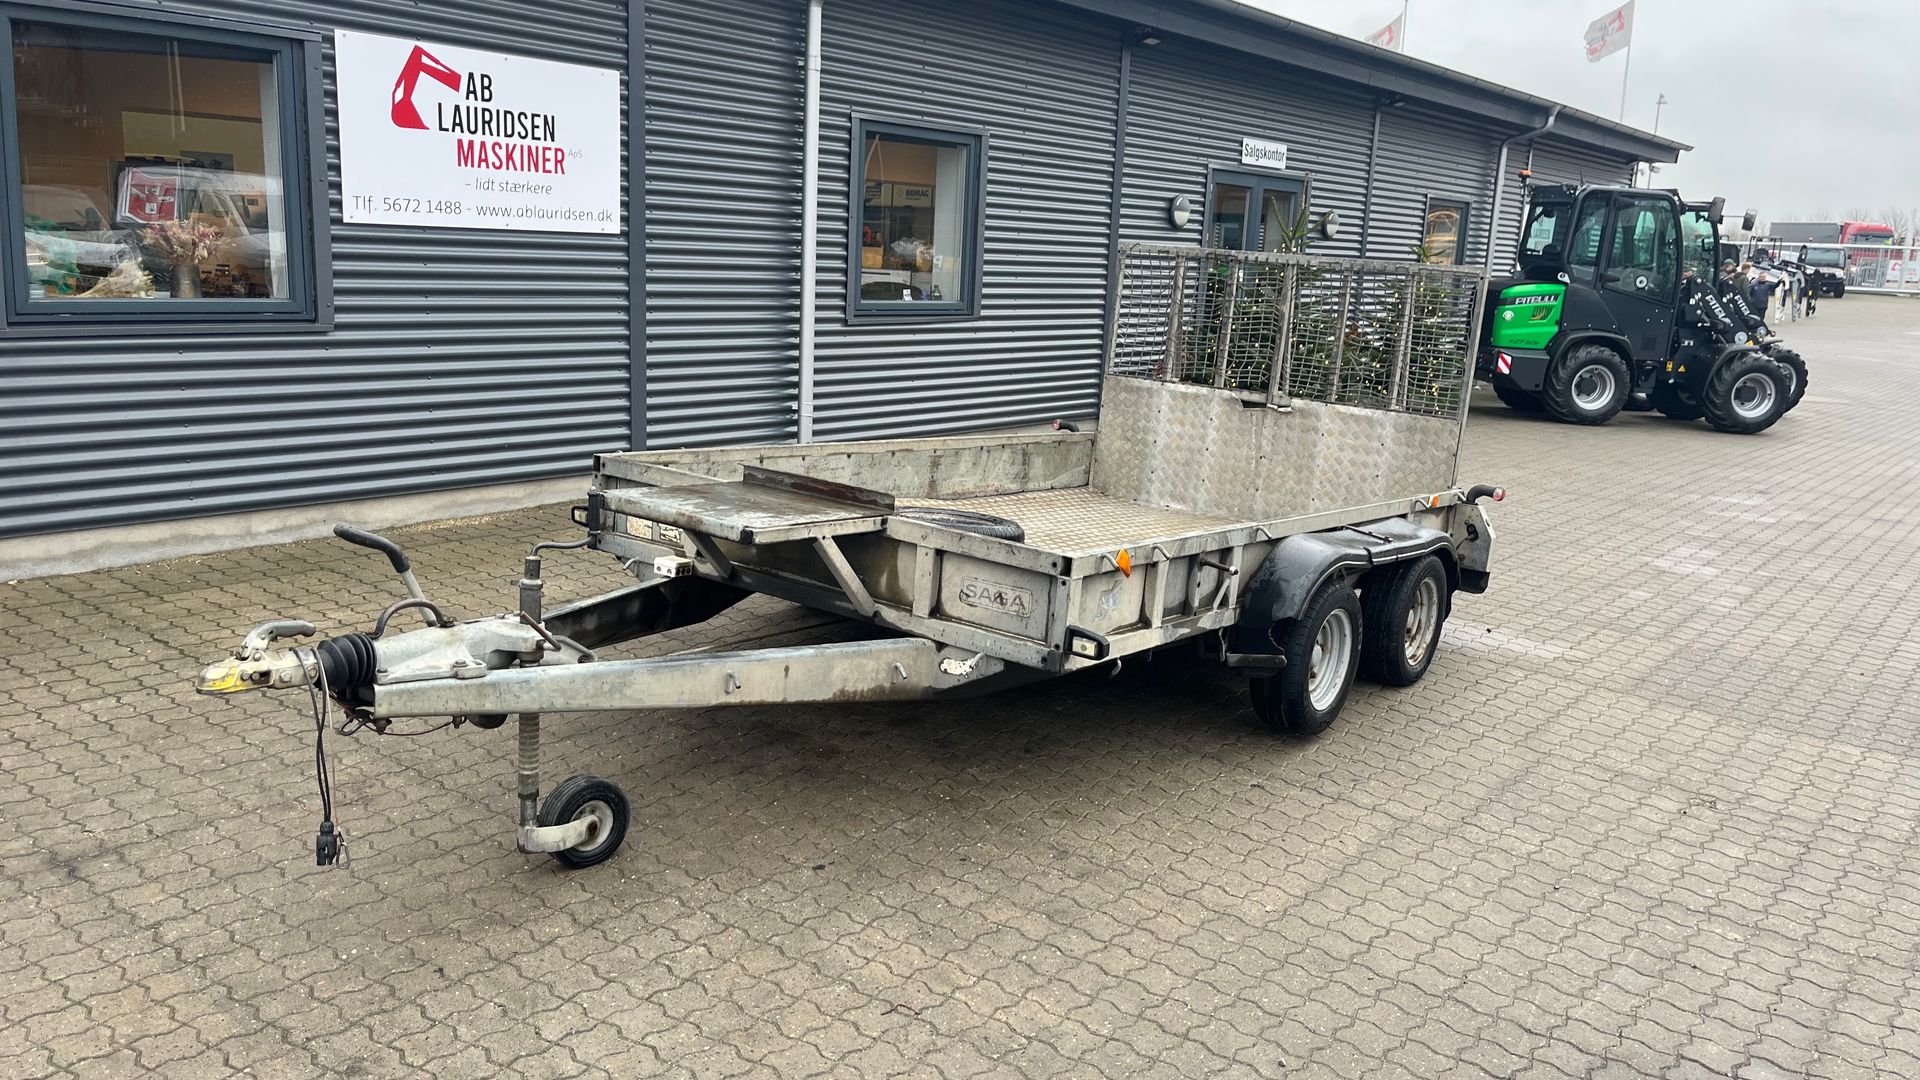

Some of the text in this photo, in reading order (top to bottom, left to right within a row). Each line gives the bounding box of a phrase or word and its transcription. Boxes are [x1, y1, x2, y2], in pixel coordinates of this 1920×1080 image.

[465, 71, 493, 102] AB
[437, 102, 556, 142] LAURIDSEN
[456, 138, 583, 175] MASKINER ApS
[1244, 143, 1285, 162] Salgskontor
[475, 177, 496, 192] lidt
[498, 180, 553, 195] stærkere
[352, 195, 377, 214] Tlf.
[383, 197, 421, 213] 5672
[426, 199, 462, 215] 1488
[476, 204, 613, 222] www.ablauridsen.dk
